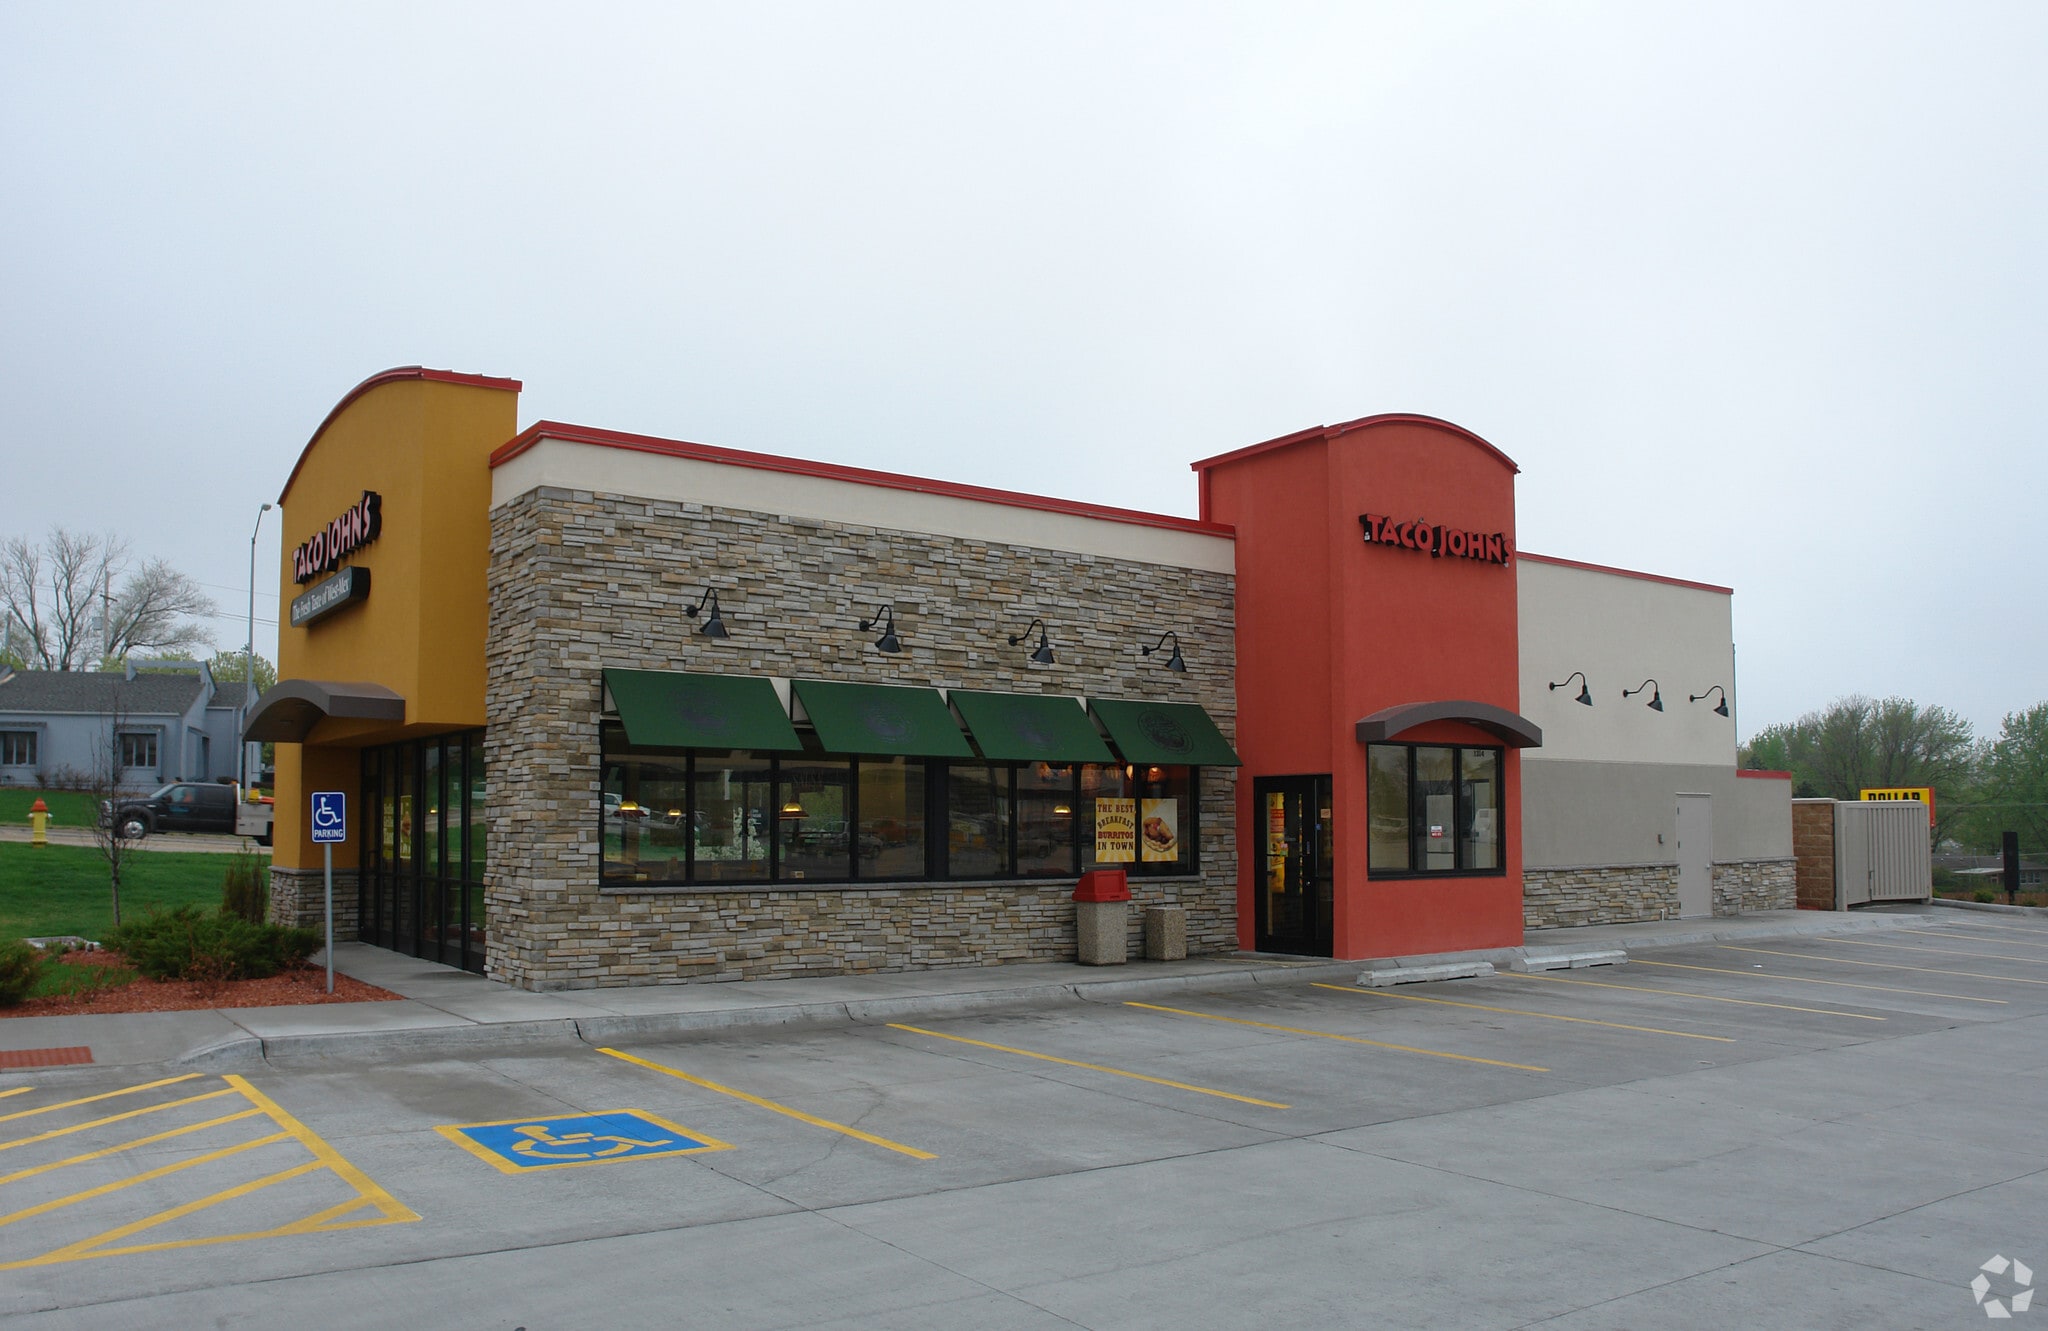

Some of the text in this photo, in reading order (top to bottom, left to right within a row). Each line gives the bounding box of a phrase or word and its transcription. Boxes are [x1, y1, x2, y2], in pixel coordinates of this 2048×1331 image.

[1361, 514, 1434, 551] TACO
[293, 531, 325, 584] TACO
[1097, 804, 1134, 813] THE BEST
[1097, 815, 1134, 830] BREAKFAST
[314, 829, 343, 838] PARKING
[1097, 831, 1134, 839] BURRITOS
[1097, 841, 1134, 850] IN TOWN
